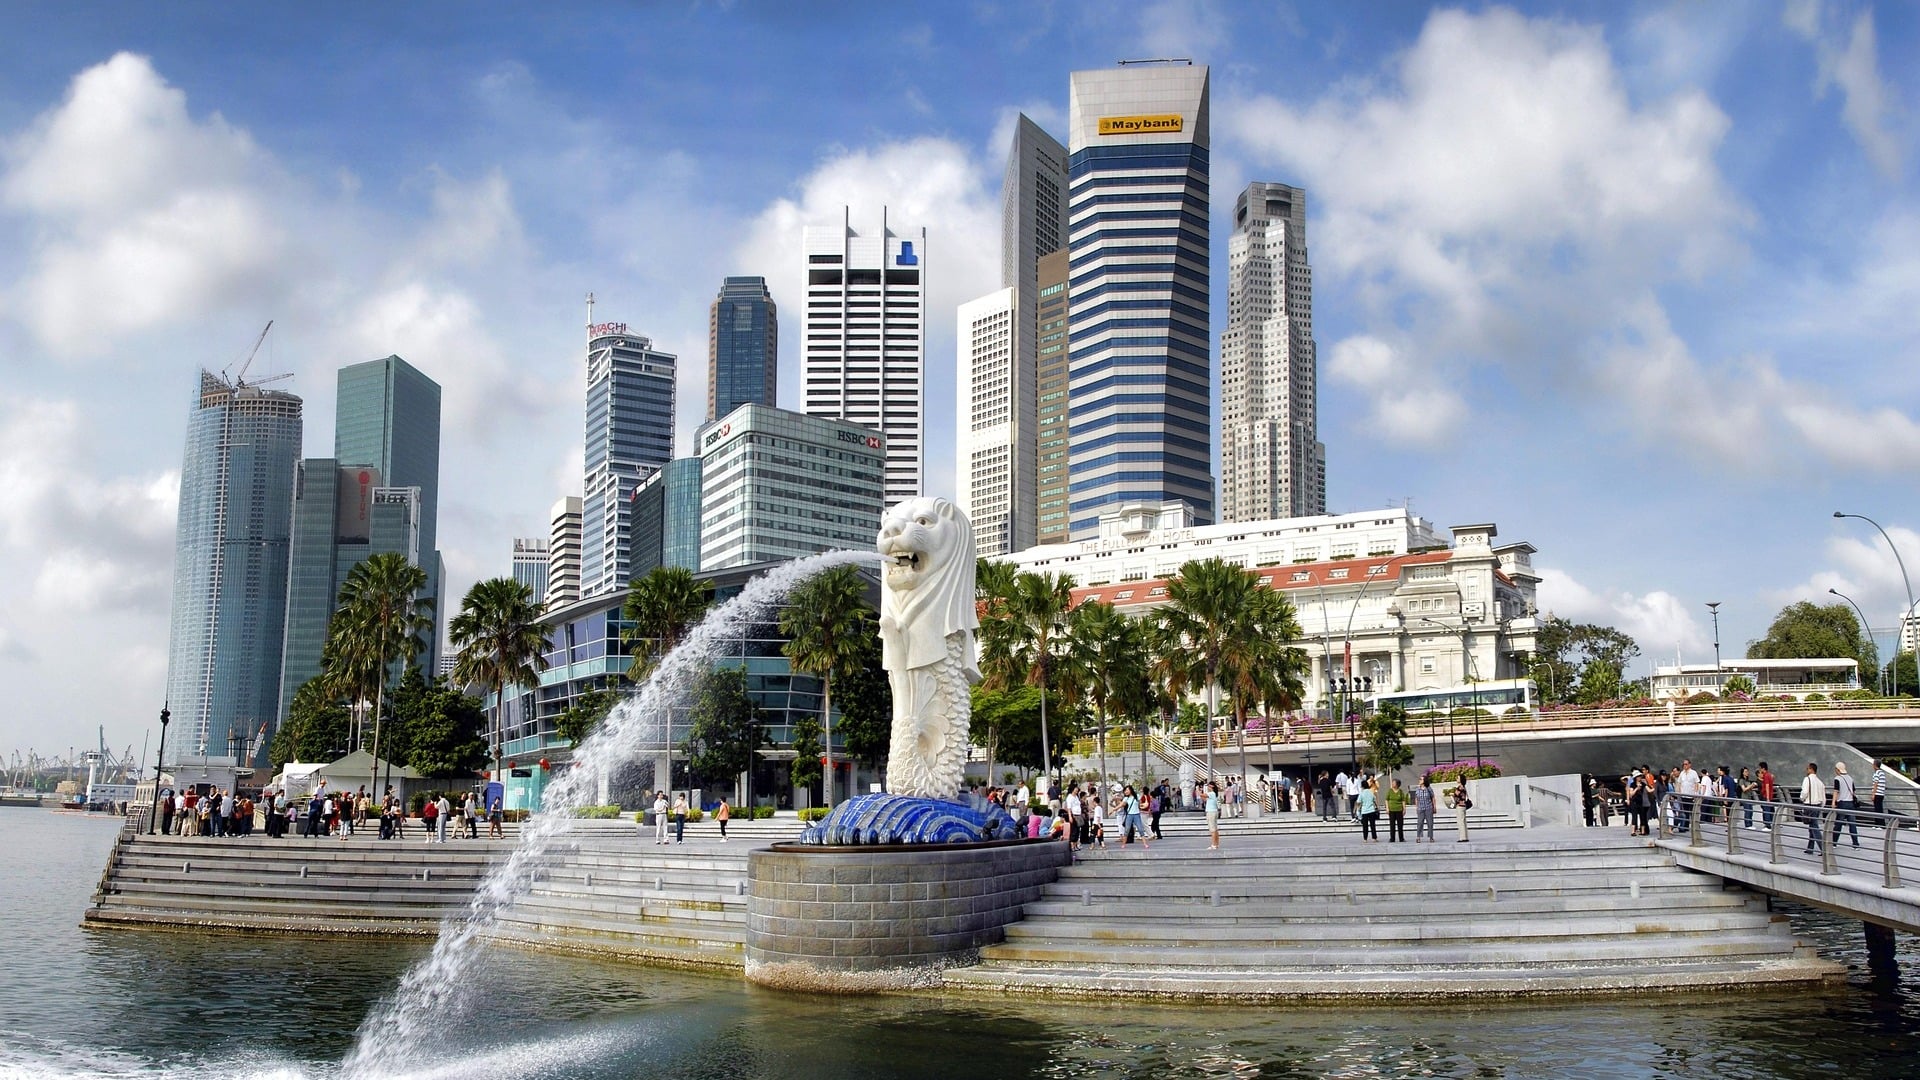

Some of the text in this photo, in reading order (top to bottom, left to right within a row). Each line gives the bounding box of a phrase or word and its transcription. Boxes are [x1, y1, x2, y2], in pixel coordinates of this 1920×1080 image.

[1112, 119, 1179, 130] Maybank
[705, 429, 721, 447] HSBC
[837, 430, 866, 445] HSBC
[1080, 542, 1098, 553] THE
[1163, 530, 1196, 542] HOTEL
